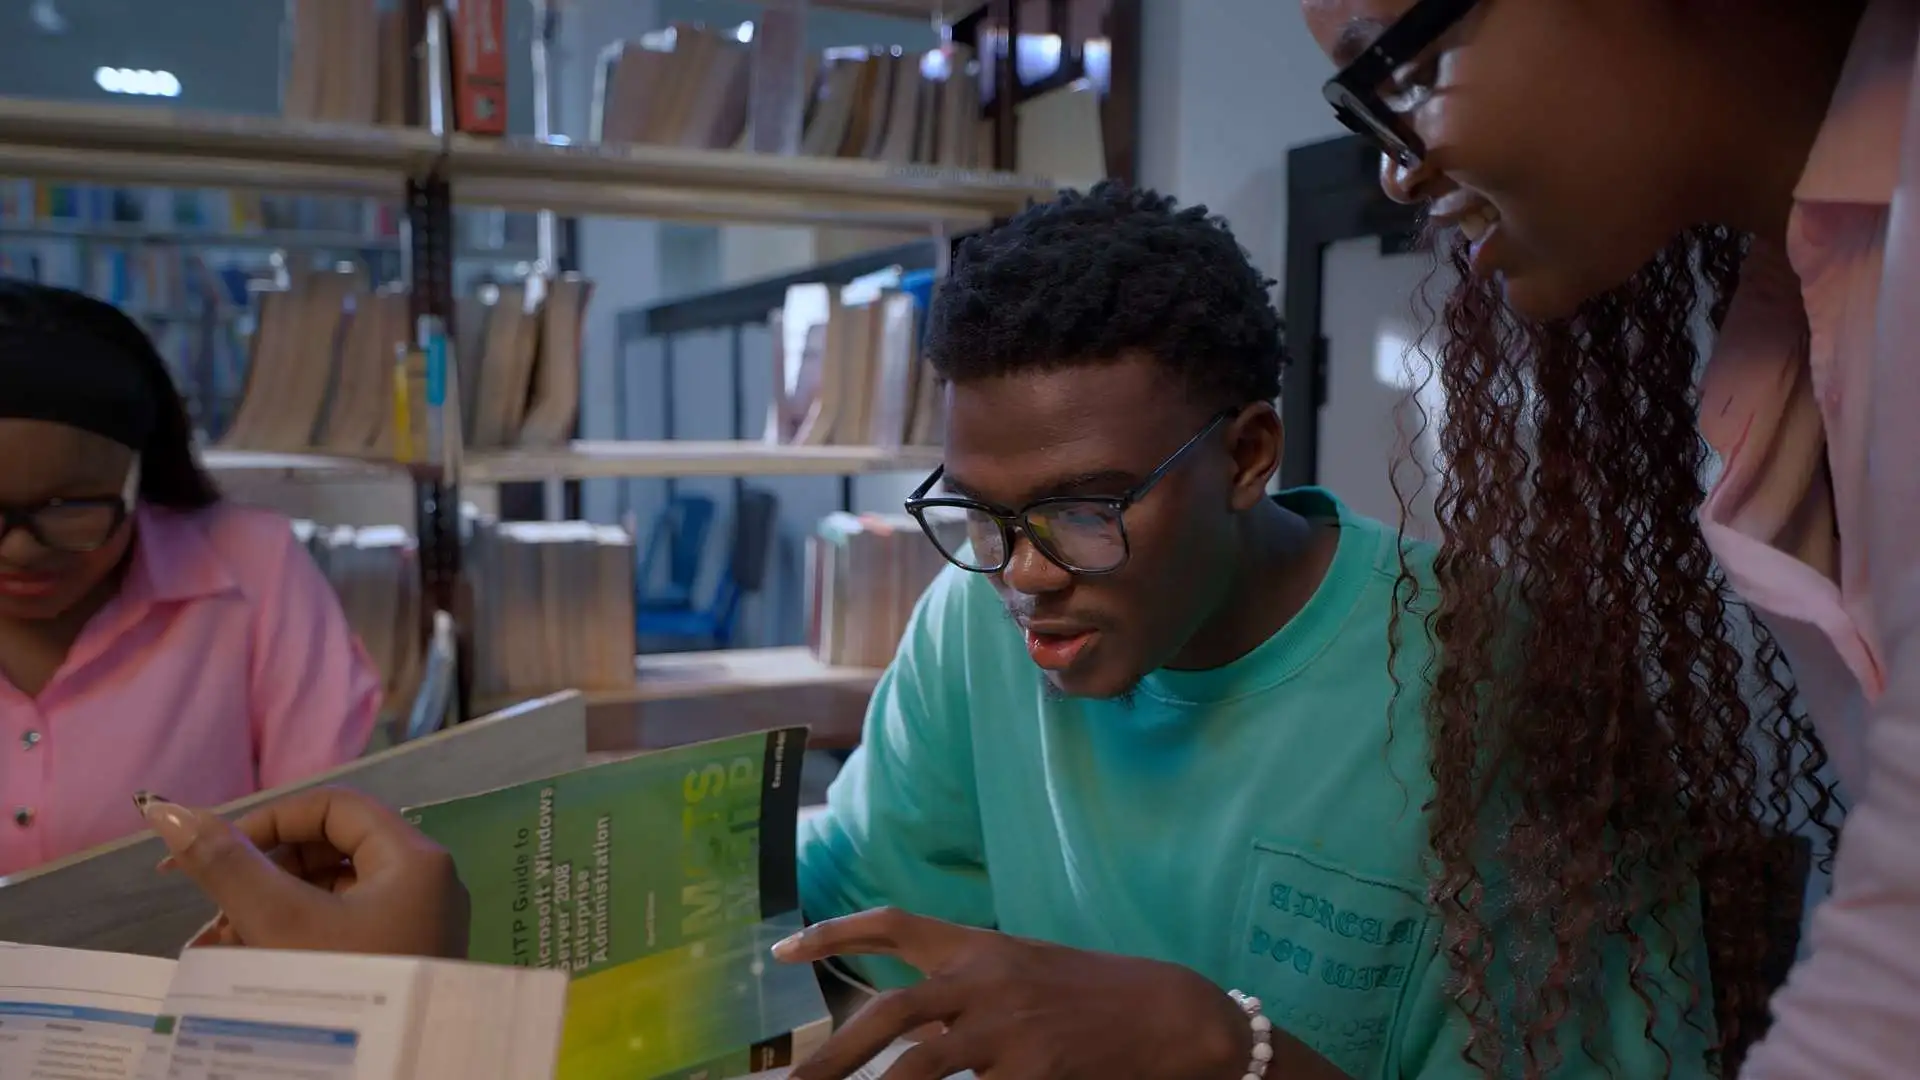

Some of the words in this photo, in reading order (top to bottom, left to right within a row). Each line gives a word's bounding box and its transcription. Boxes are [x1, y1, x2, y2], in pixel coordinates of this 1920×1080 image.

[512, 826, 530, 849] to
[535, 786, 554, 880] Windows
[511, 853, 531, 913] Guide
[554, 862, 571, 905] 2008
[592, 816, 610, 962] Administration
[555, 911, 572, 973] Server
[573, 869, 592, 973] Enterprise
